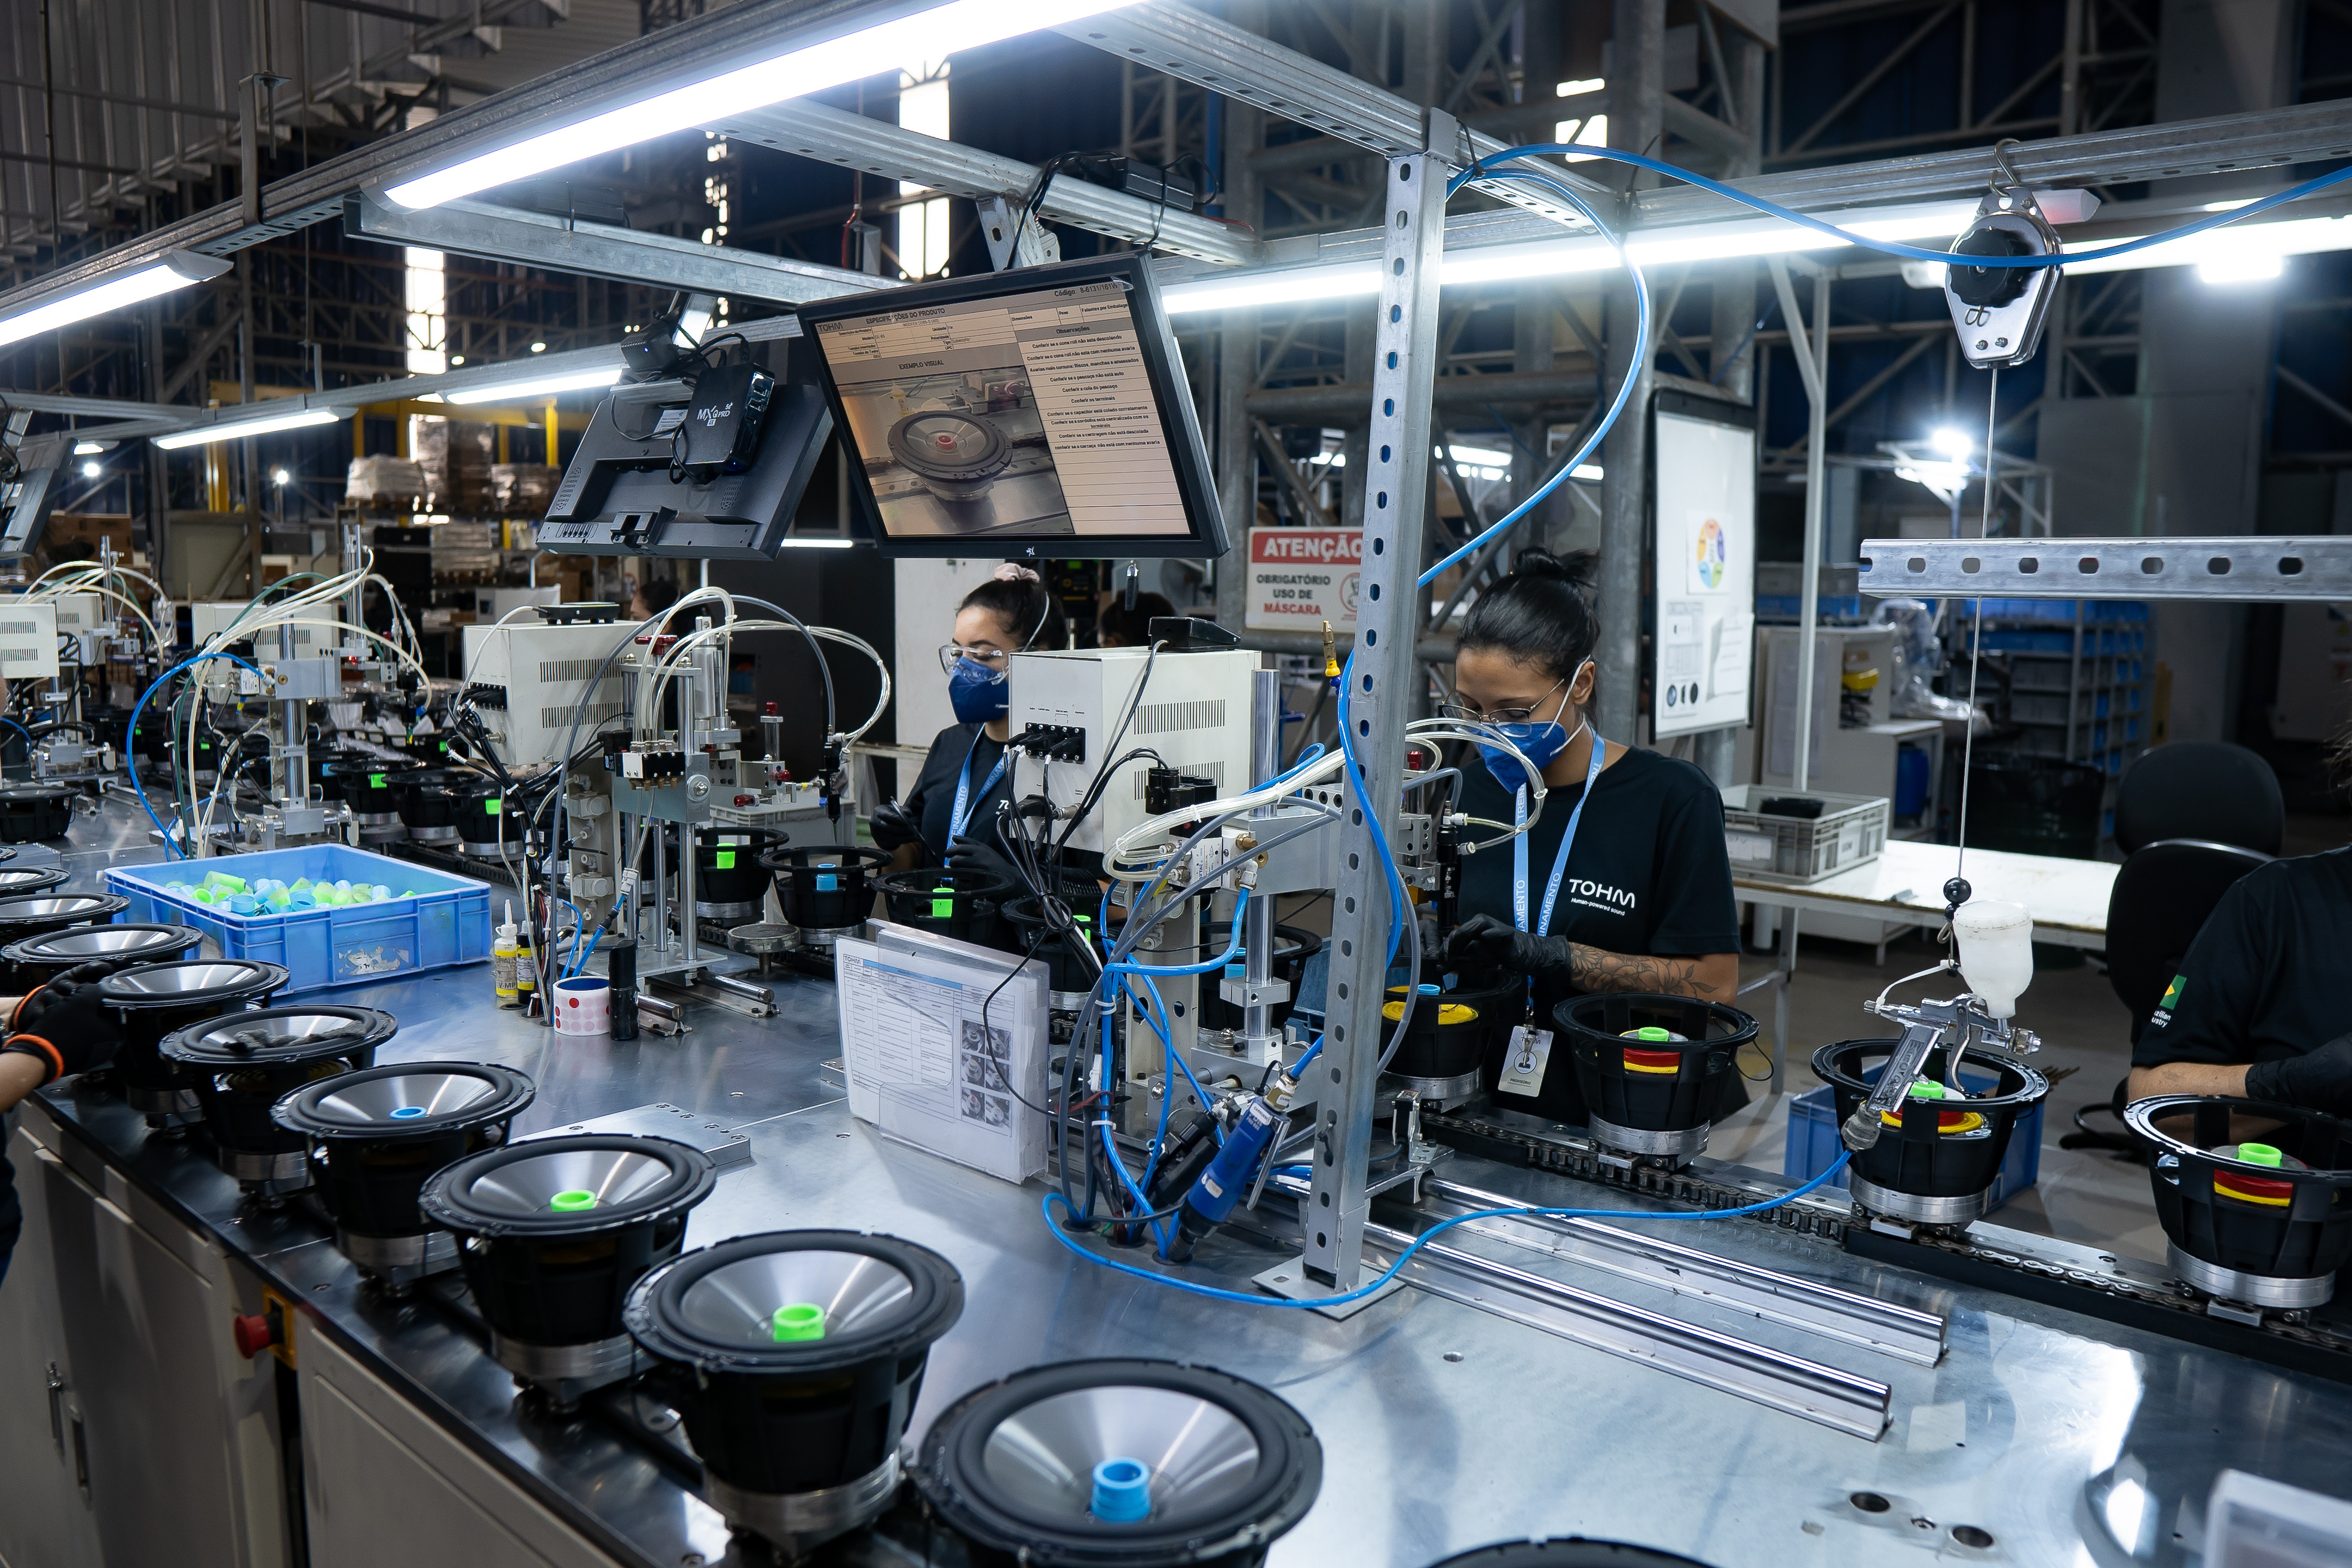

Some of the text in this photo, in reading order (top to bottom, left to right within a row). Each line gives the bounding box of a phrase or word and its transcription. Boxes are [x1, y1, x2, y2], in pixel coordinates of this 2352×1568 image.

[919, 308, 945, 317] PRODUTO
[817, 322, 843, 332] TOHM
[1056, 326, 1090, 334] Observações
[899, 362, 923, 370] EXEMPLO
[1263, 534, 1363, 562] ATENÇÃO
[1257, 572, 1331, 586] OBRIGATÓRIO
[1273, 589, 1313, 599] USO DE
[1263, 601, 1322, 615] MÁSCARA
[1569, 879, 1635, 908] TOHM
[1516, 880, 1526, 932] AMENTO
[1610, 907, 1625, 916] sound
[844, 956, 861, 964] TOHM
